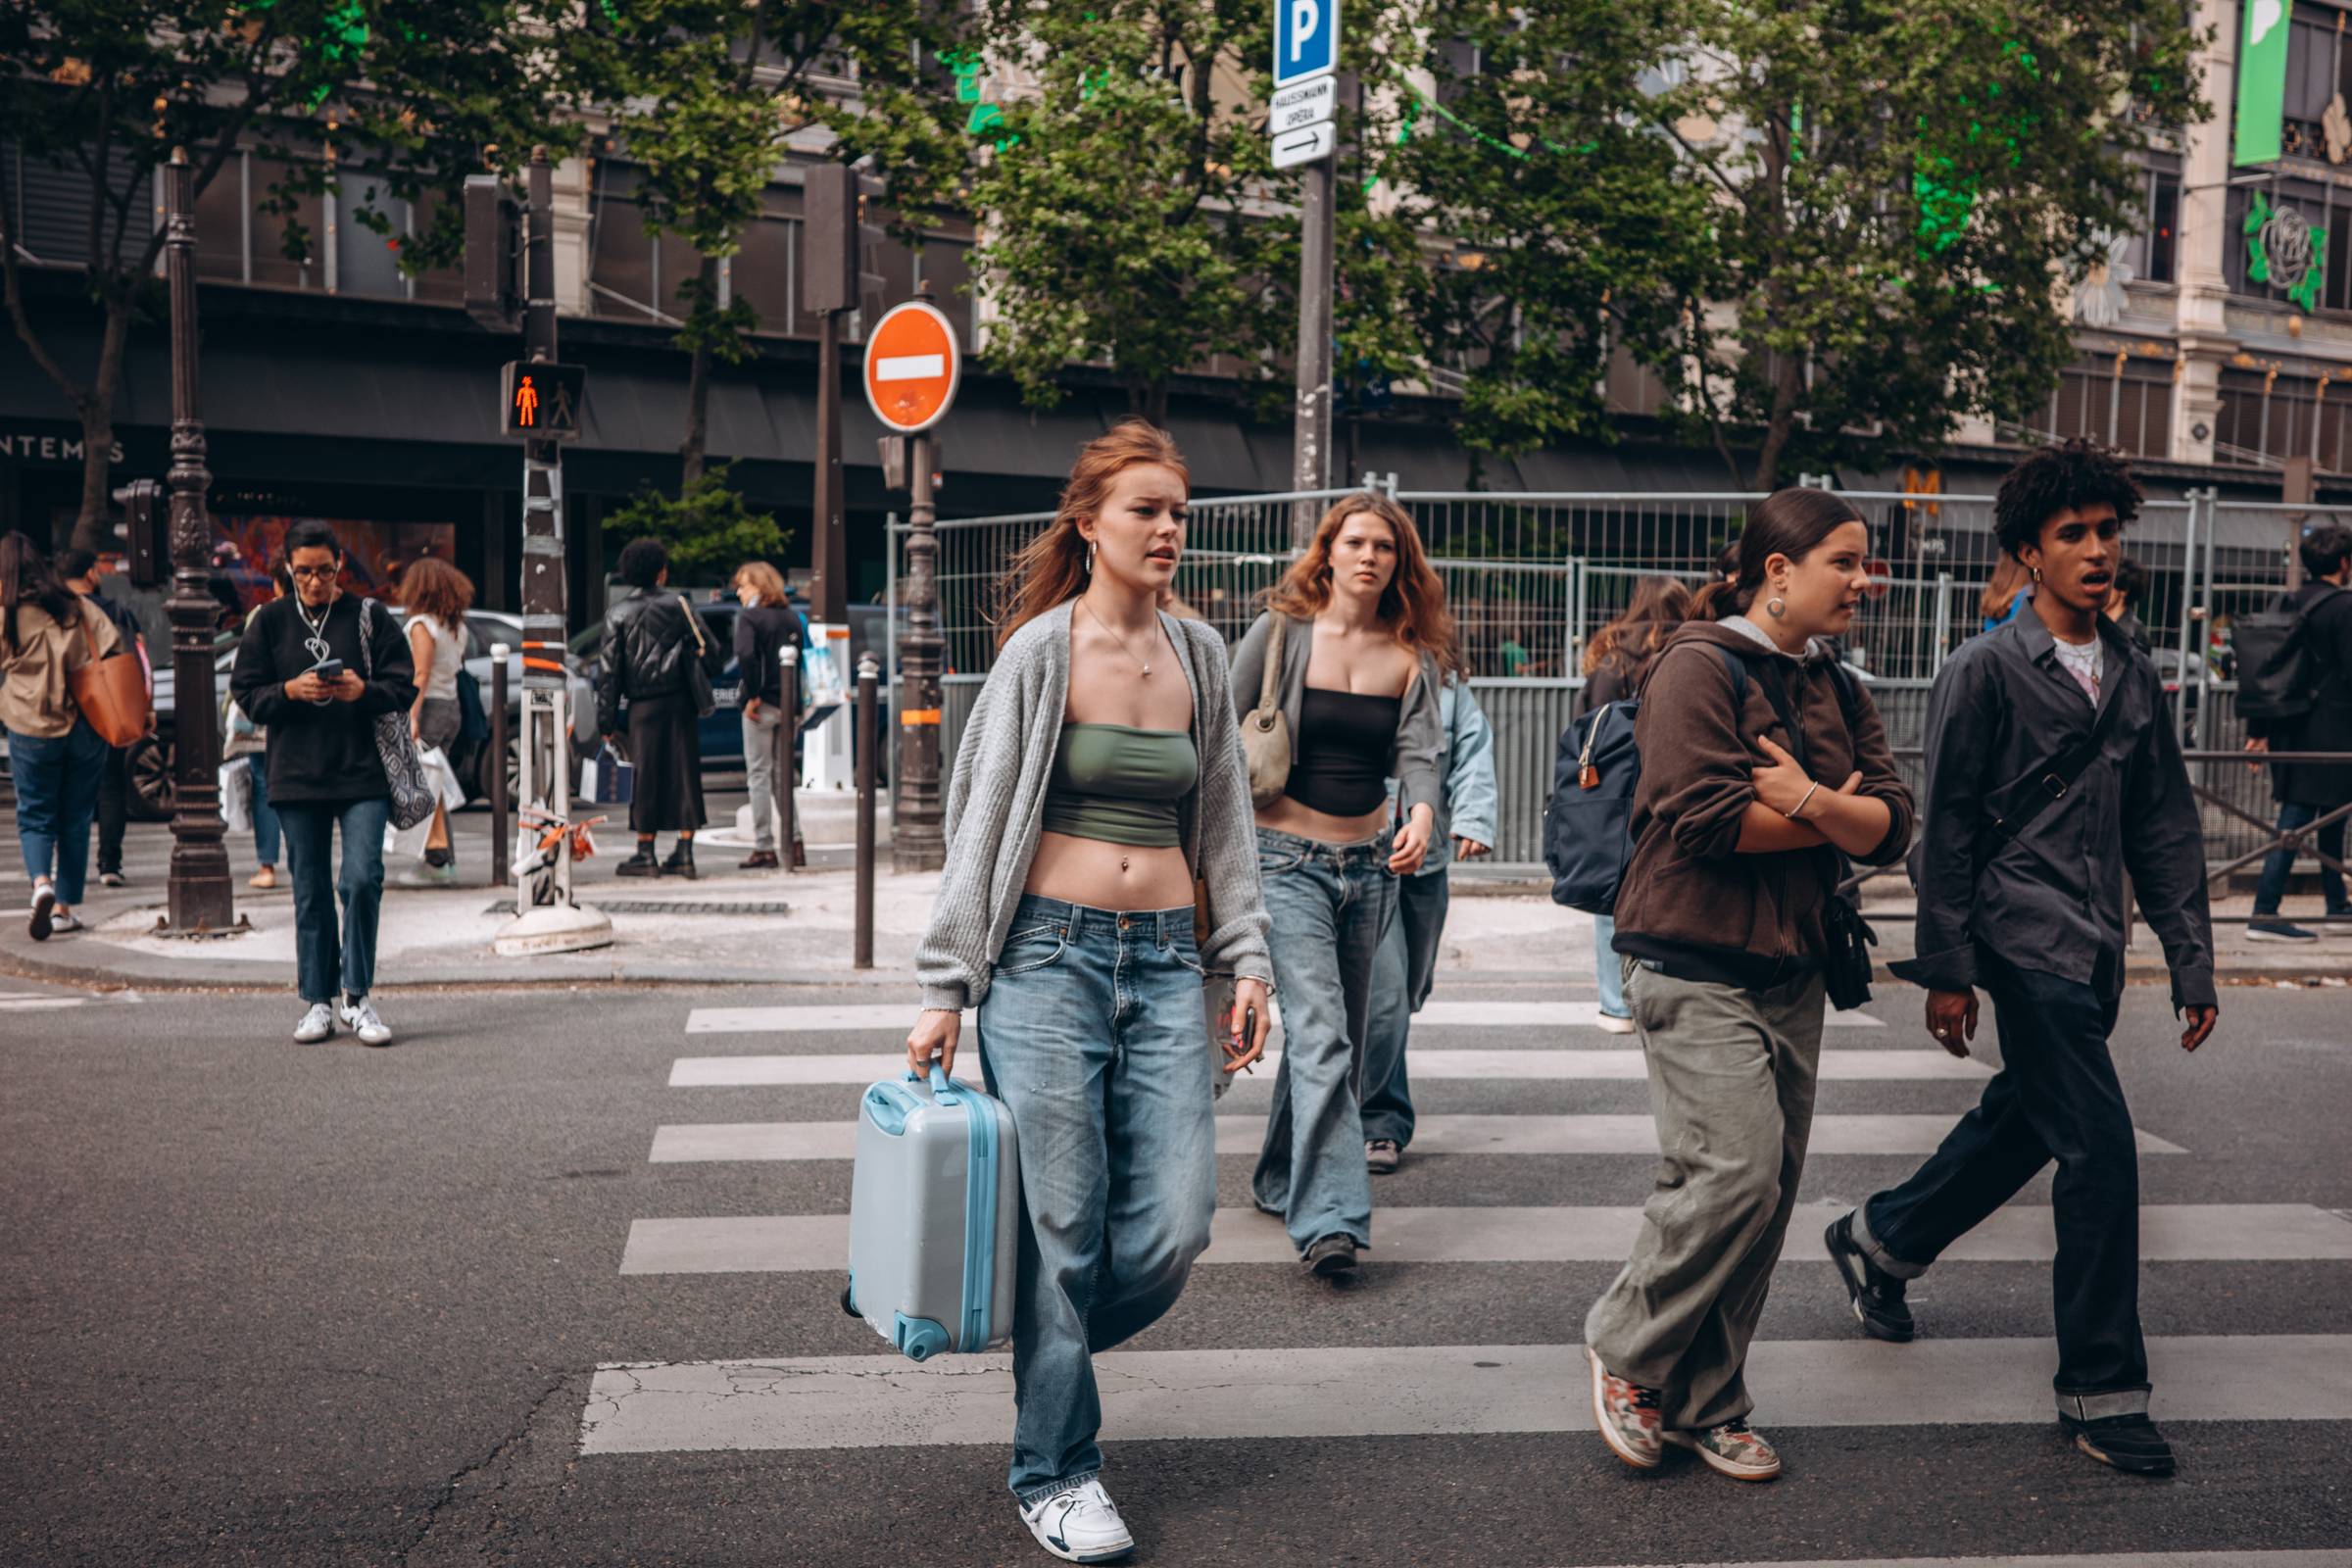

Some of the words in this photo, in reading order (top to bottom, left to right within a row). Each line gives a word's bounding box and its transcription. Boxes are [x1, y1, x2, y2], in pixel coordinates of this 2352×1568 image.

[1291, 0, 1319, 62] P
[0, 435, 124, 464] NTEMS
[1903, 468, 1940, 516] M
